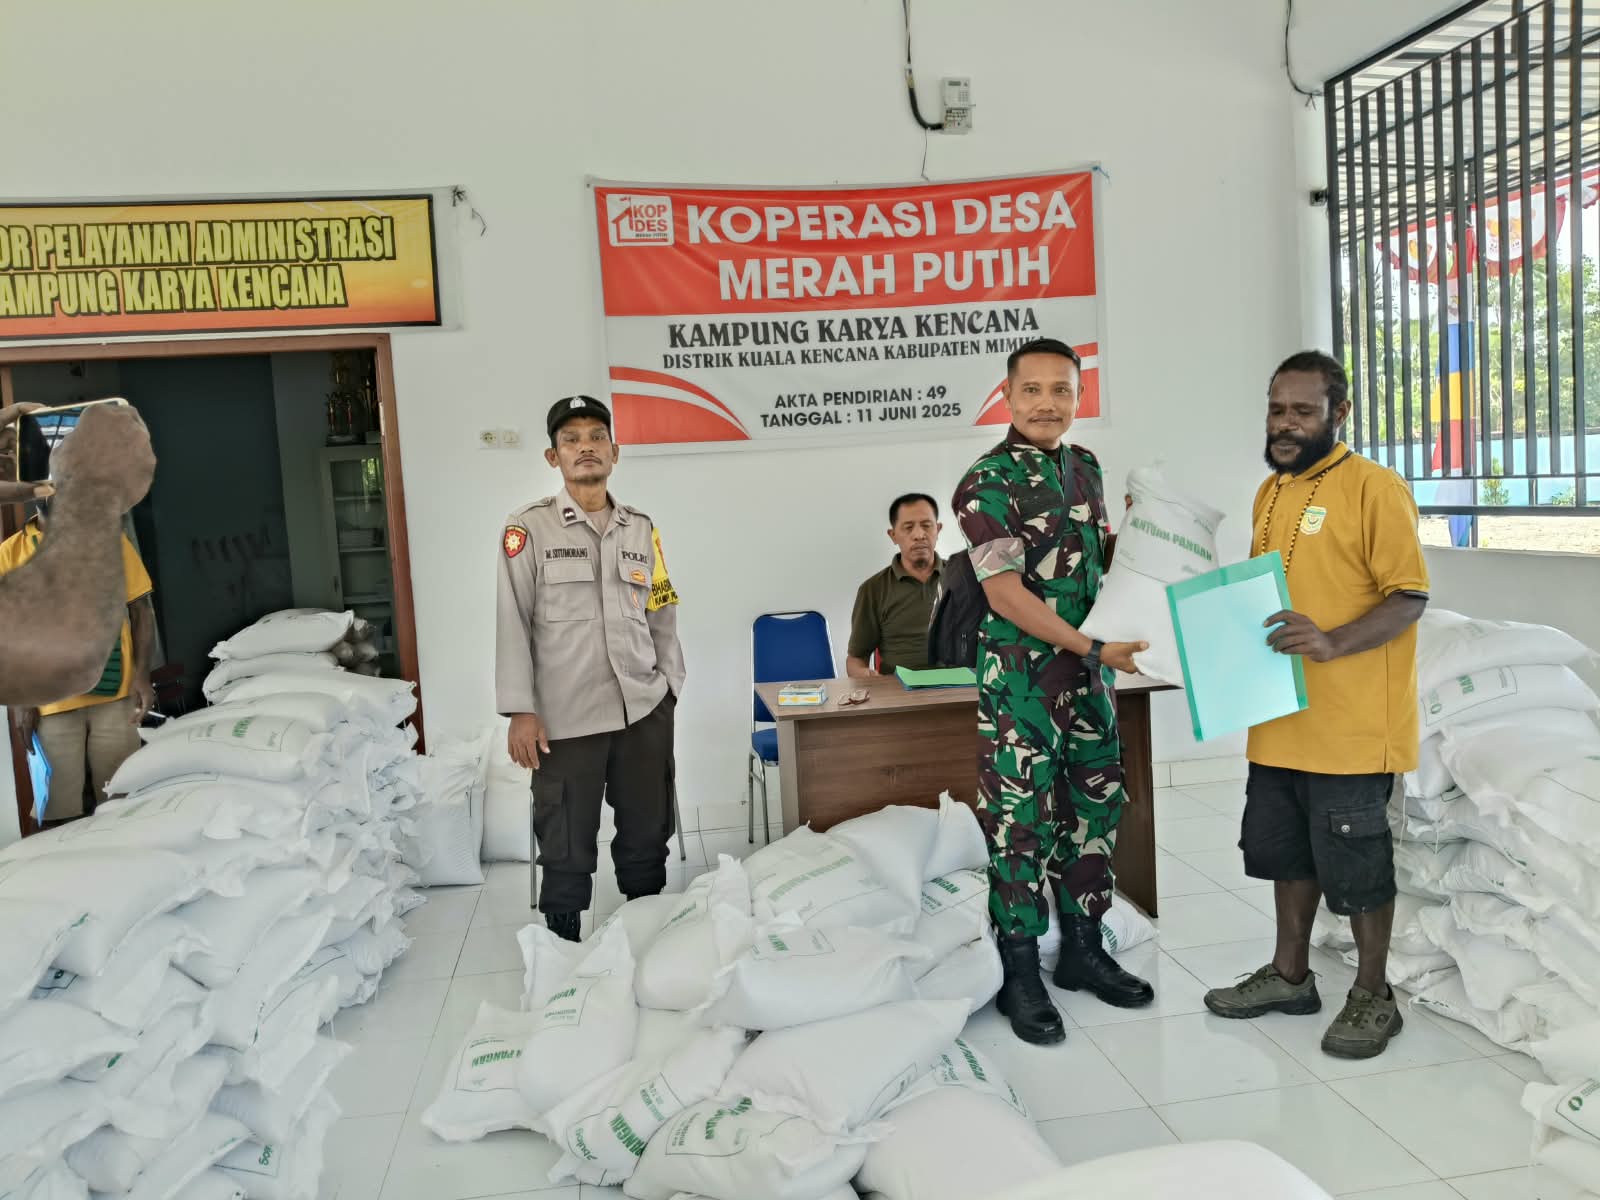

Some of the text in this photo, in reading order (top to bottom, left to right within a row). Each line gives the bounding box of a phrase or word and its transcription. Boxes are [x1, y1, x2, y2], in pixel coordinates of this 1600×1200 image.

[633, 204, 668, 218] KOP
[634, 219, 668, 232] DES
[687, 190, 1077, 244] KOPERASI DESA
[34, 221, 193, 270] PELAYANAN
[194, 215, 396, 265] ADMINISTRASI
[718, 245, 1050, 301] MERAH PUTIH
[120, 266, 219, 314] KARYA
[216, 262, 349, 311] KENCANA
[668, 308, 1040, 348] KAMPUNG KARYA KENCANA
[663, 353, 733, 368] DISTRIK
[738, 350, 797, 367] KUALA
[801, 346, 880, 364] KENCANA
[884, 339, 981, 360] KABUPATEN
[774, 385, 947, 409] AKTA PENDIRIAN : 49
[760, 402, 962, 427] TANGGAL : 11 JUNI 2025
[621, 551, 648, 564] POLRI
